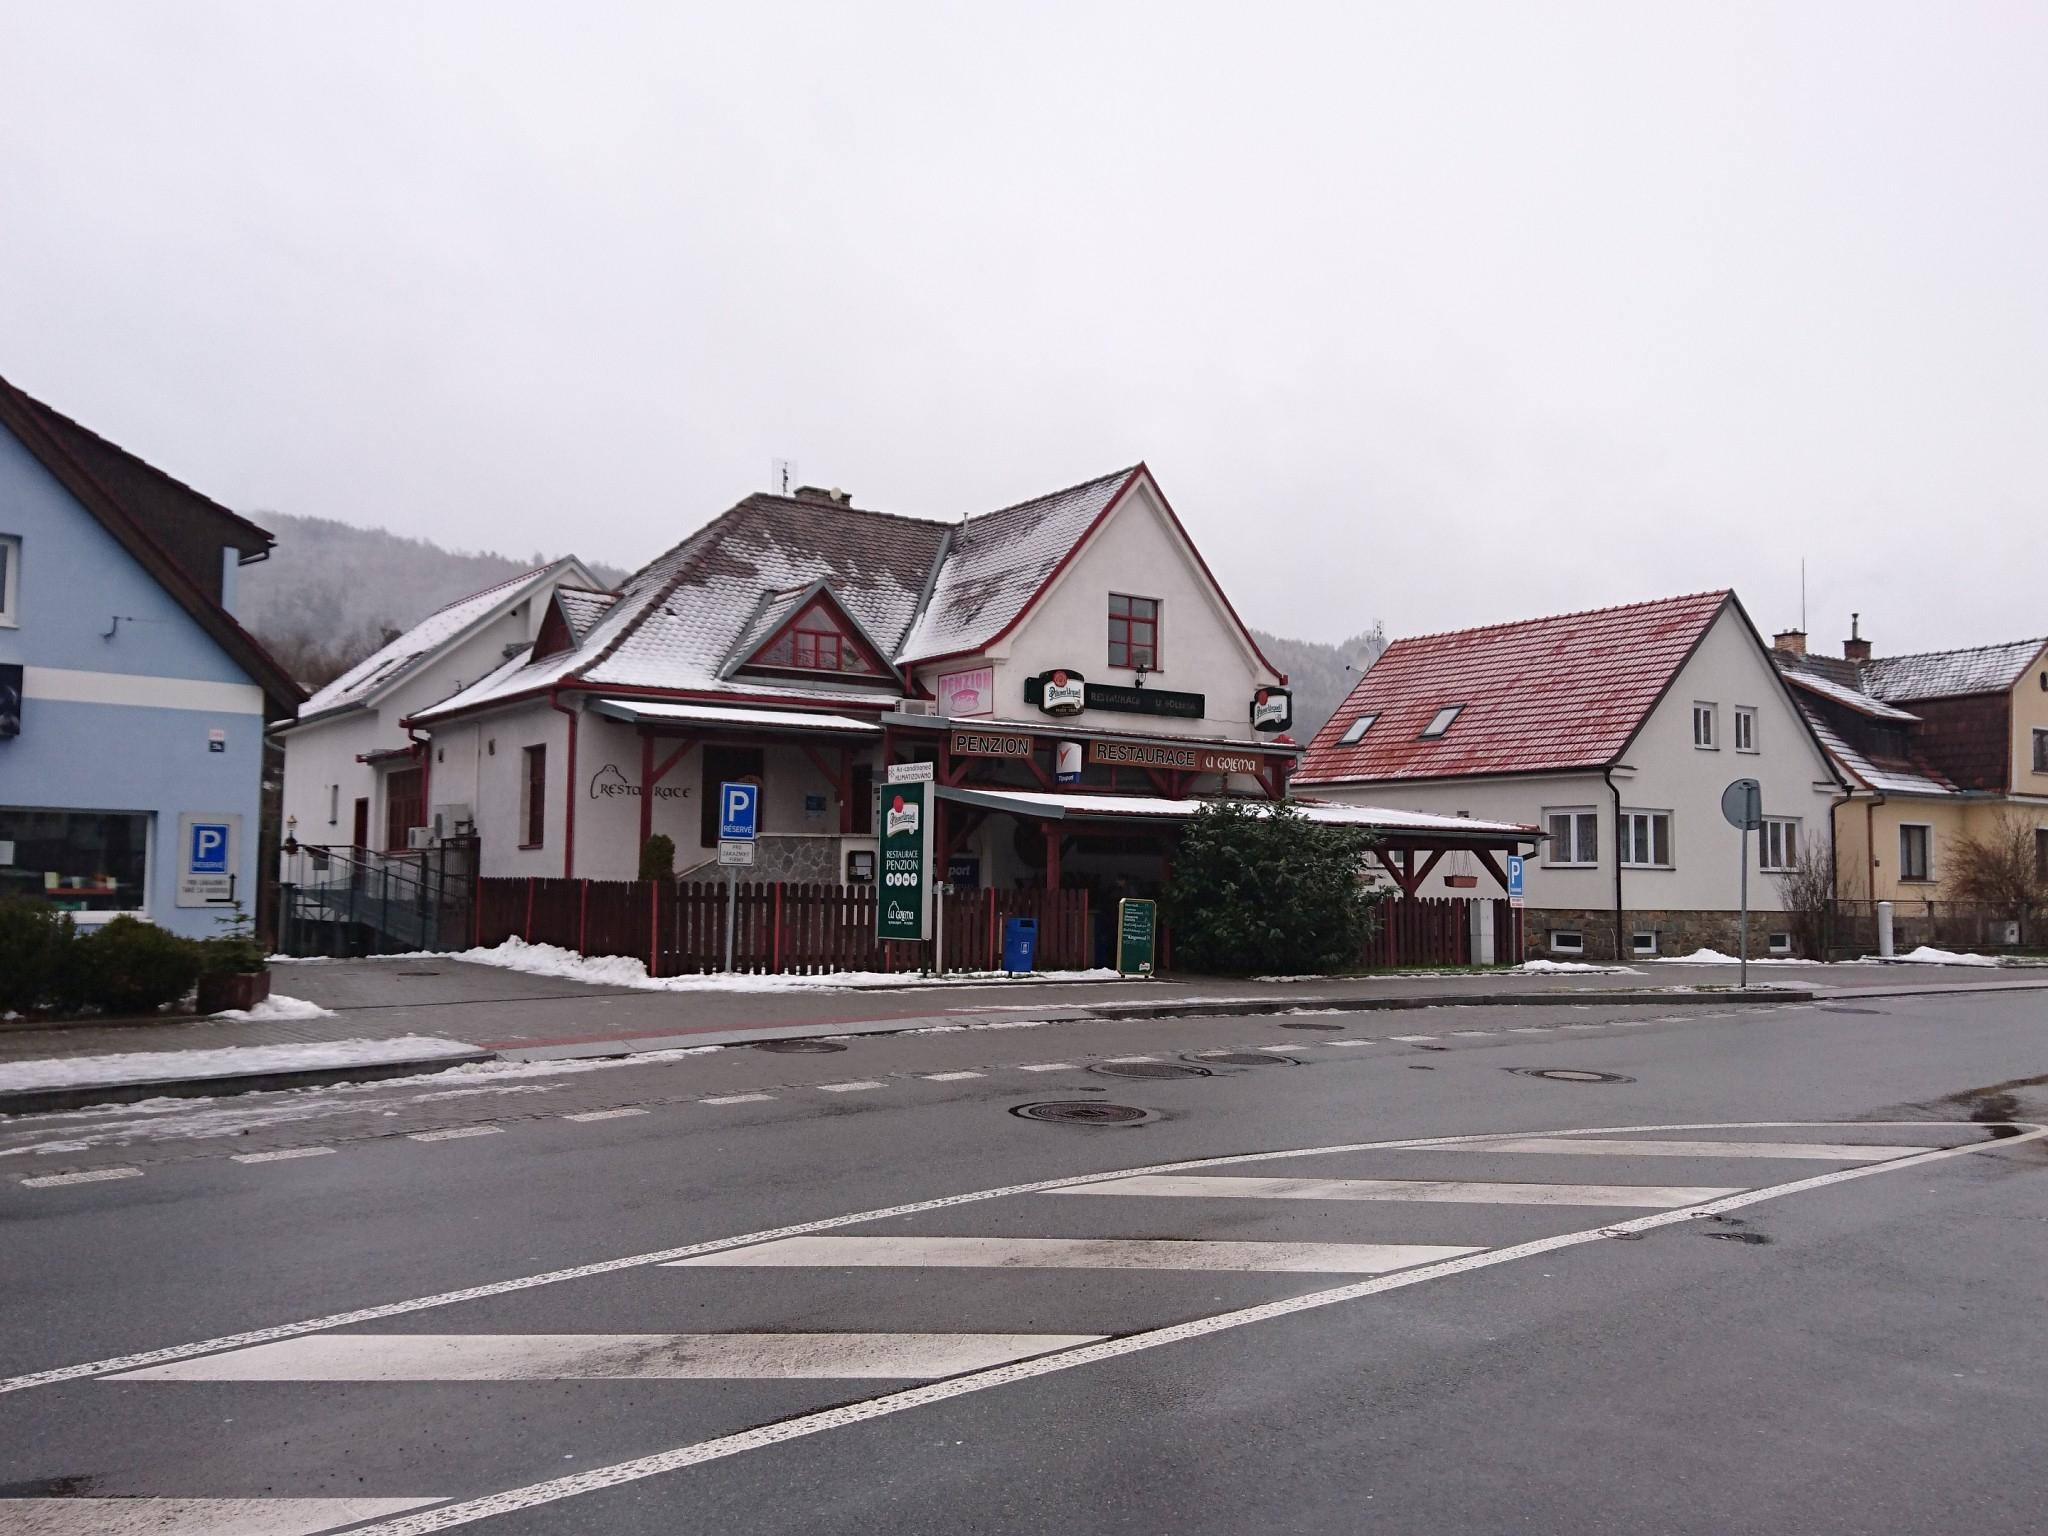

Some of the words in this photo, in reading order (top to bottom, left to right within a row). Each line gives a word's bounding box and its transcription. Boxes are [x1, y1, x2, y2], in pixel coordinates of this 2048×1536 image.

[941, 671, 991, 697] PENZION
[955, 735, 1030, 756] PENZION
[1097, 743, 1195, 767] RESTAURACE
[729, 790, 750, 822] P
[198, 830, 220, 858] P
[886, 850, 919, 859] RESTAURACE
[886, 859, 919, 871] PENZION
[1511, 861, 1521, 884] P
